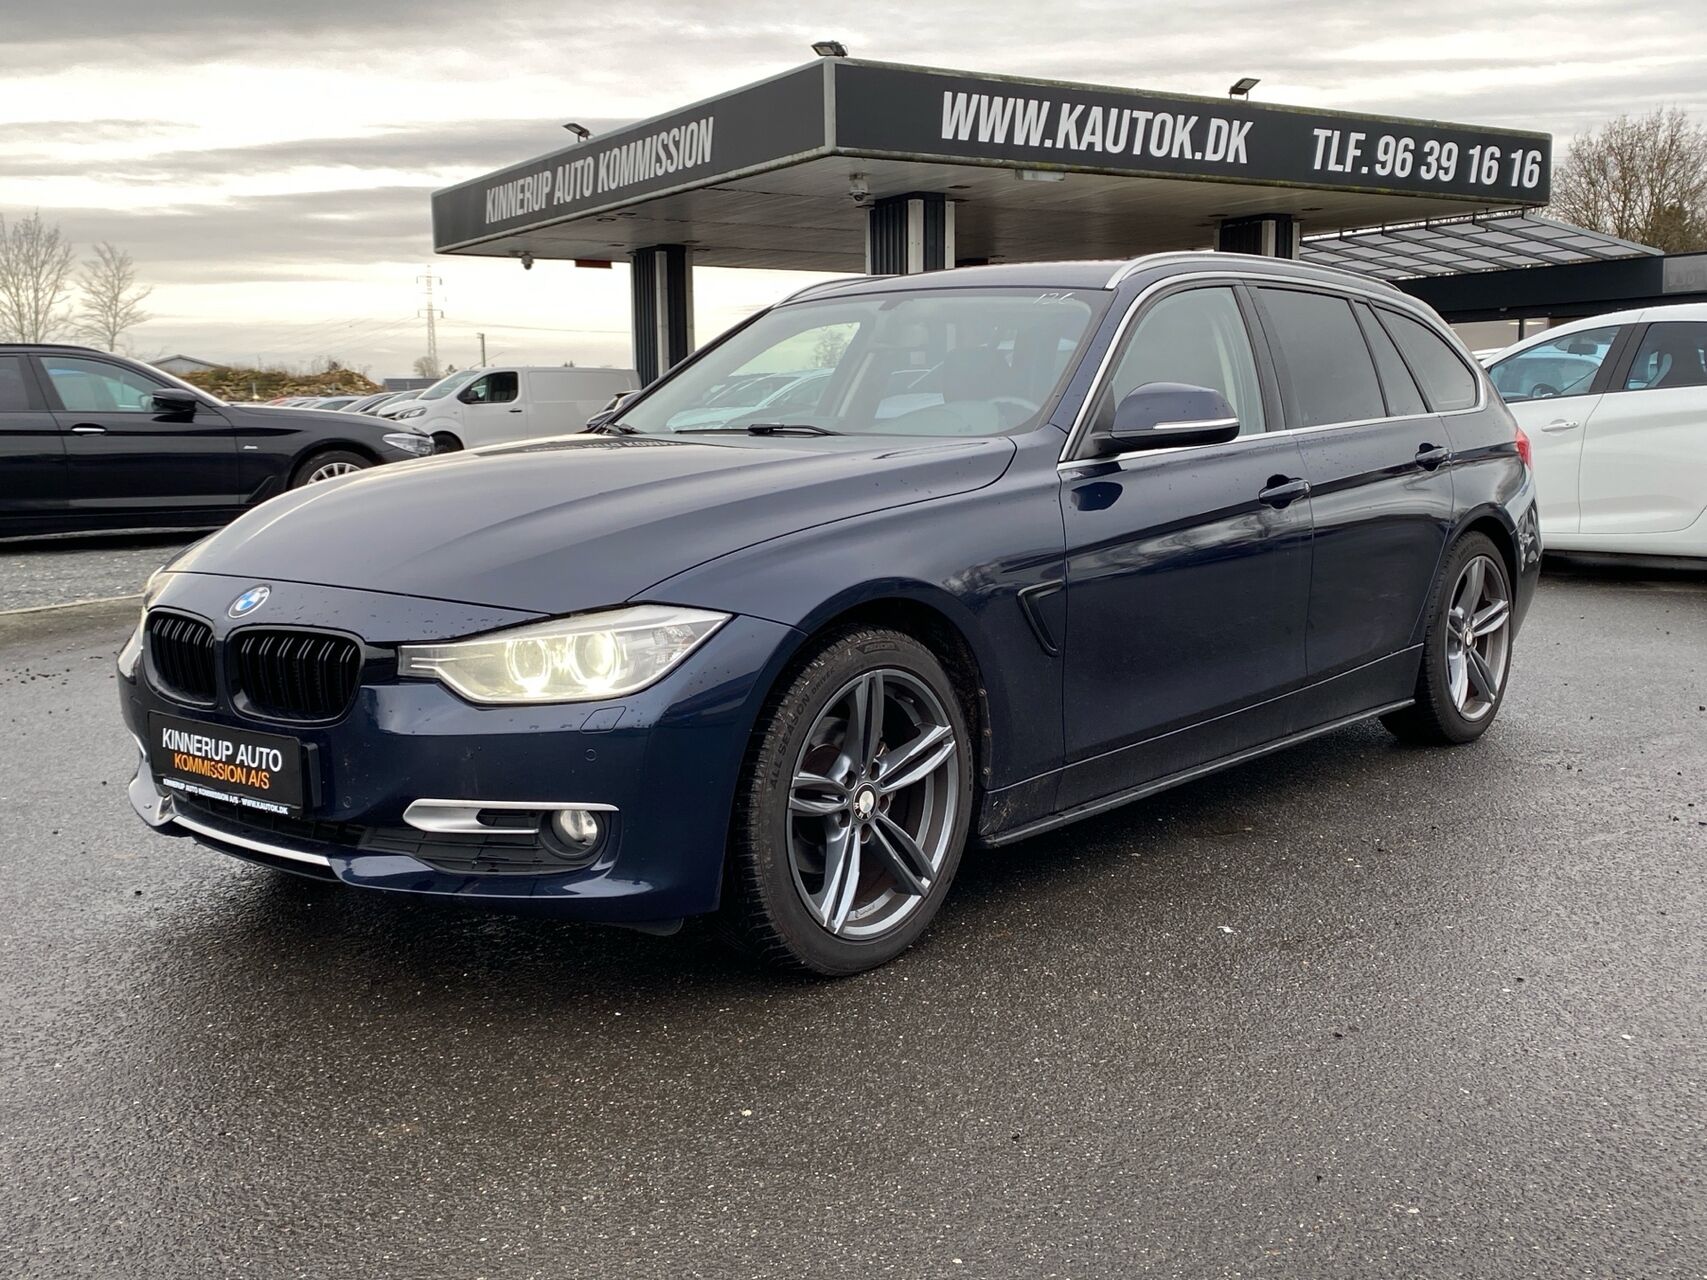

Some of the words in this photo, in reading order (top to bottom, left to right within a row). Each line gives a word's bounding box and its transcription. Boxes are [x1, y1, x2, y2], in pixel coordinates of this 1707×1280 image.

[941, 91, 1254, 164] WWW.KAUTOK.DK
[485, 170, 552, 224] KINNERUP
[553, 156, 595, 206] AUTO
[597, 116, 714, 193] KOMMISSION
[1312, 128, 1369, 174] TLF.
[1375, 135, 1416, 178] 96
[1420, 140, 1459, 182] 39
[1469, 144, 1501, 186] 16
[1510, 148, 1543, 189] 16
[162, 727, 233, 761] KINNERUP
[235, 744, 282, 772] AUTO
[174, 753, 246, 784] KOMMISSION
[248, 769, 271, 790] A/S
